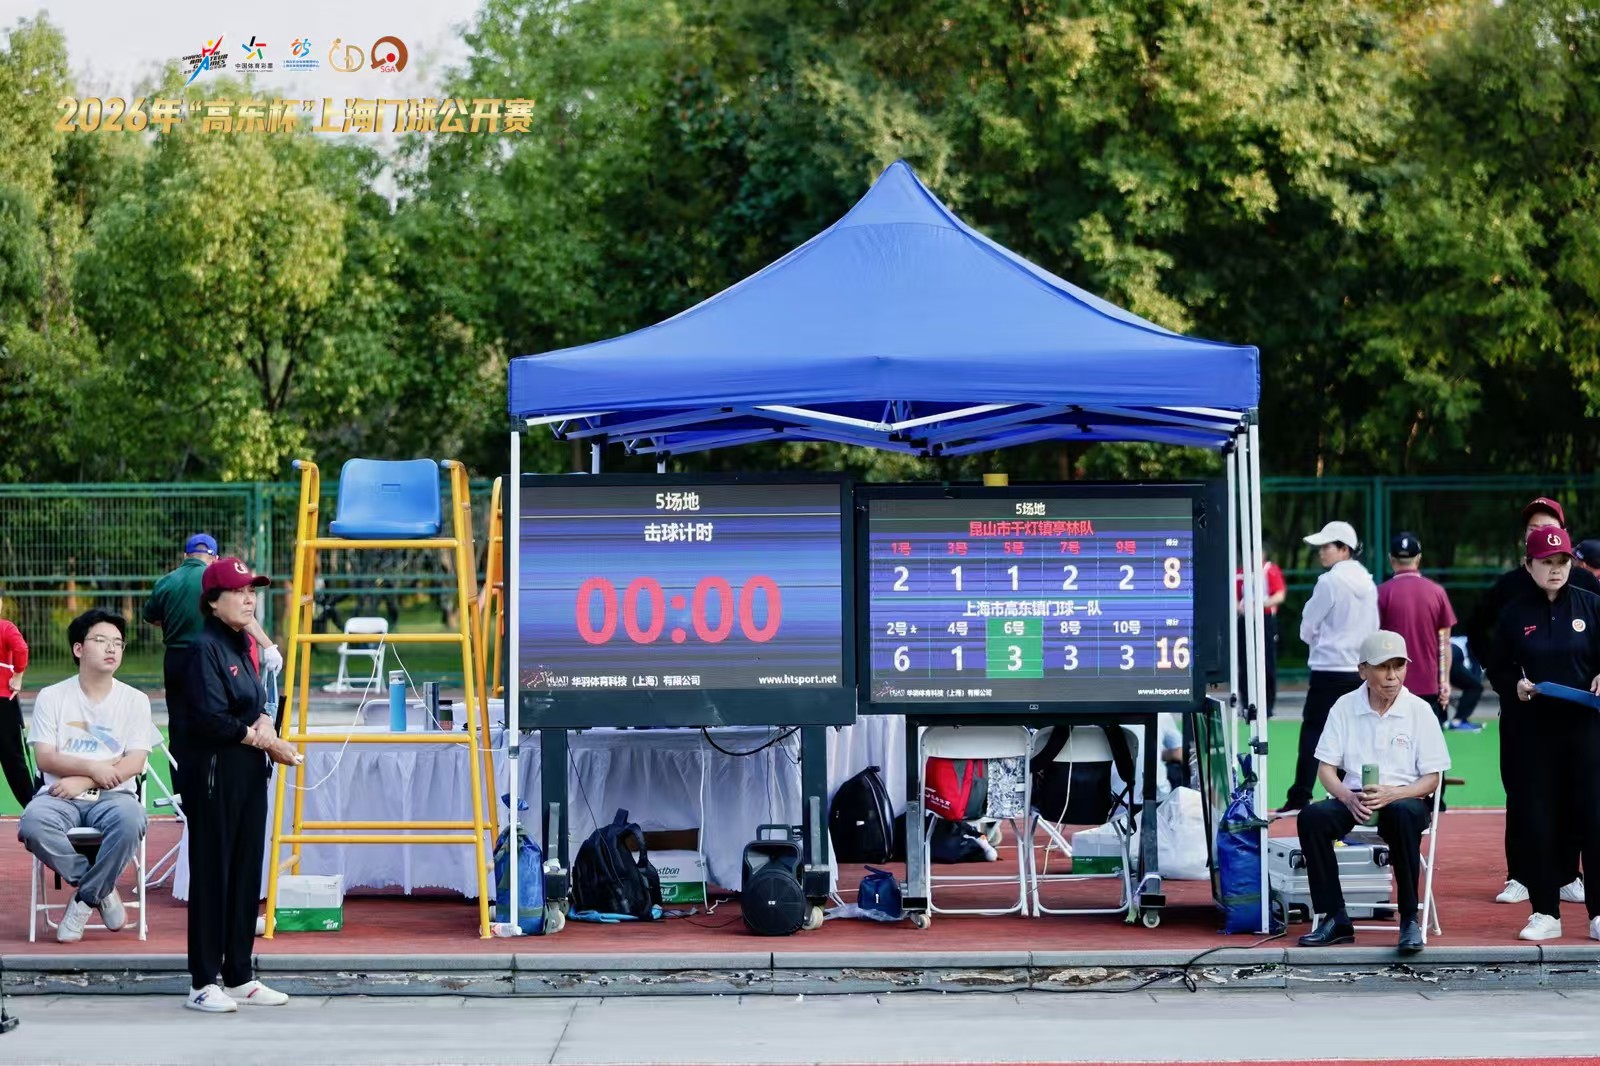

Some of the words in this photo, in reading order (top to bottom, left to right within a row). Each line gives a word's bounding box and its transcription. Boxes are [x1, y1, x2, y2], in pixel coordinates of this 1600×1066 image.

[655, 491, 700, 511] 5场地
[1015, 502, 1046, 516] 5场地
[644, 523, 714, 542] 击球计时
[891, 542, 912, 556] 1号
[947, 542, 968, 556] 3号
[1004, 541, 1024, 556] 5号
[1060, 541, 1081, 555] 7号
[1116, 541, 1137, 554] 9号
[893, 566, 909, 591] 2
[951, 565, 962, 591] 1
[1007, 565, 1019, 590] 1
[1062, 565, 1078, 590] 2
[1119, 565, 1135, 590] 2
[1163, 557, 1181, 589] 8
[576, 576, 782, 644] 00:00
[962, 600, 1102, 617] 上海市高东镇门球一队
[887, 621, 908, 636] 2号
[947, 621, 969, 636] 4号
[1004, 620, 1025, 636] 6号
[1060, 621, 1081, 635] 8号
[1112, 620, 1141, 635] 10号
[893, 646, 910, 671] 6
[951, 646, 963, 671] 1
[1007, 645, 1023, 671] 3
[1064, 645, 1079, 670] 3
[1119, 645, 1135, 670] 3
[1156, 636, 1190, 669] 16
[758, 674, 837, 686] www.htsport.net
[1137, 688, 1190, 696] www.htsport.net
[63, 738, 98, 753] ANTA
